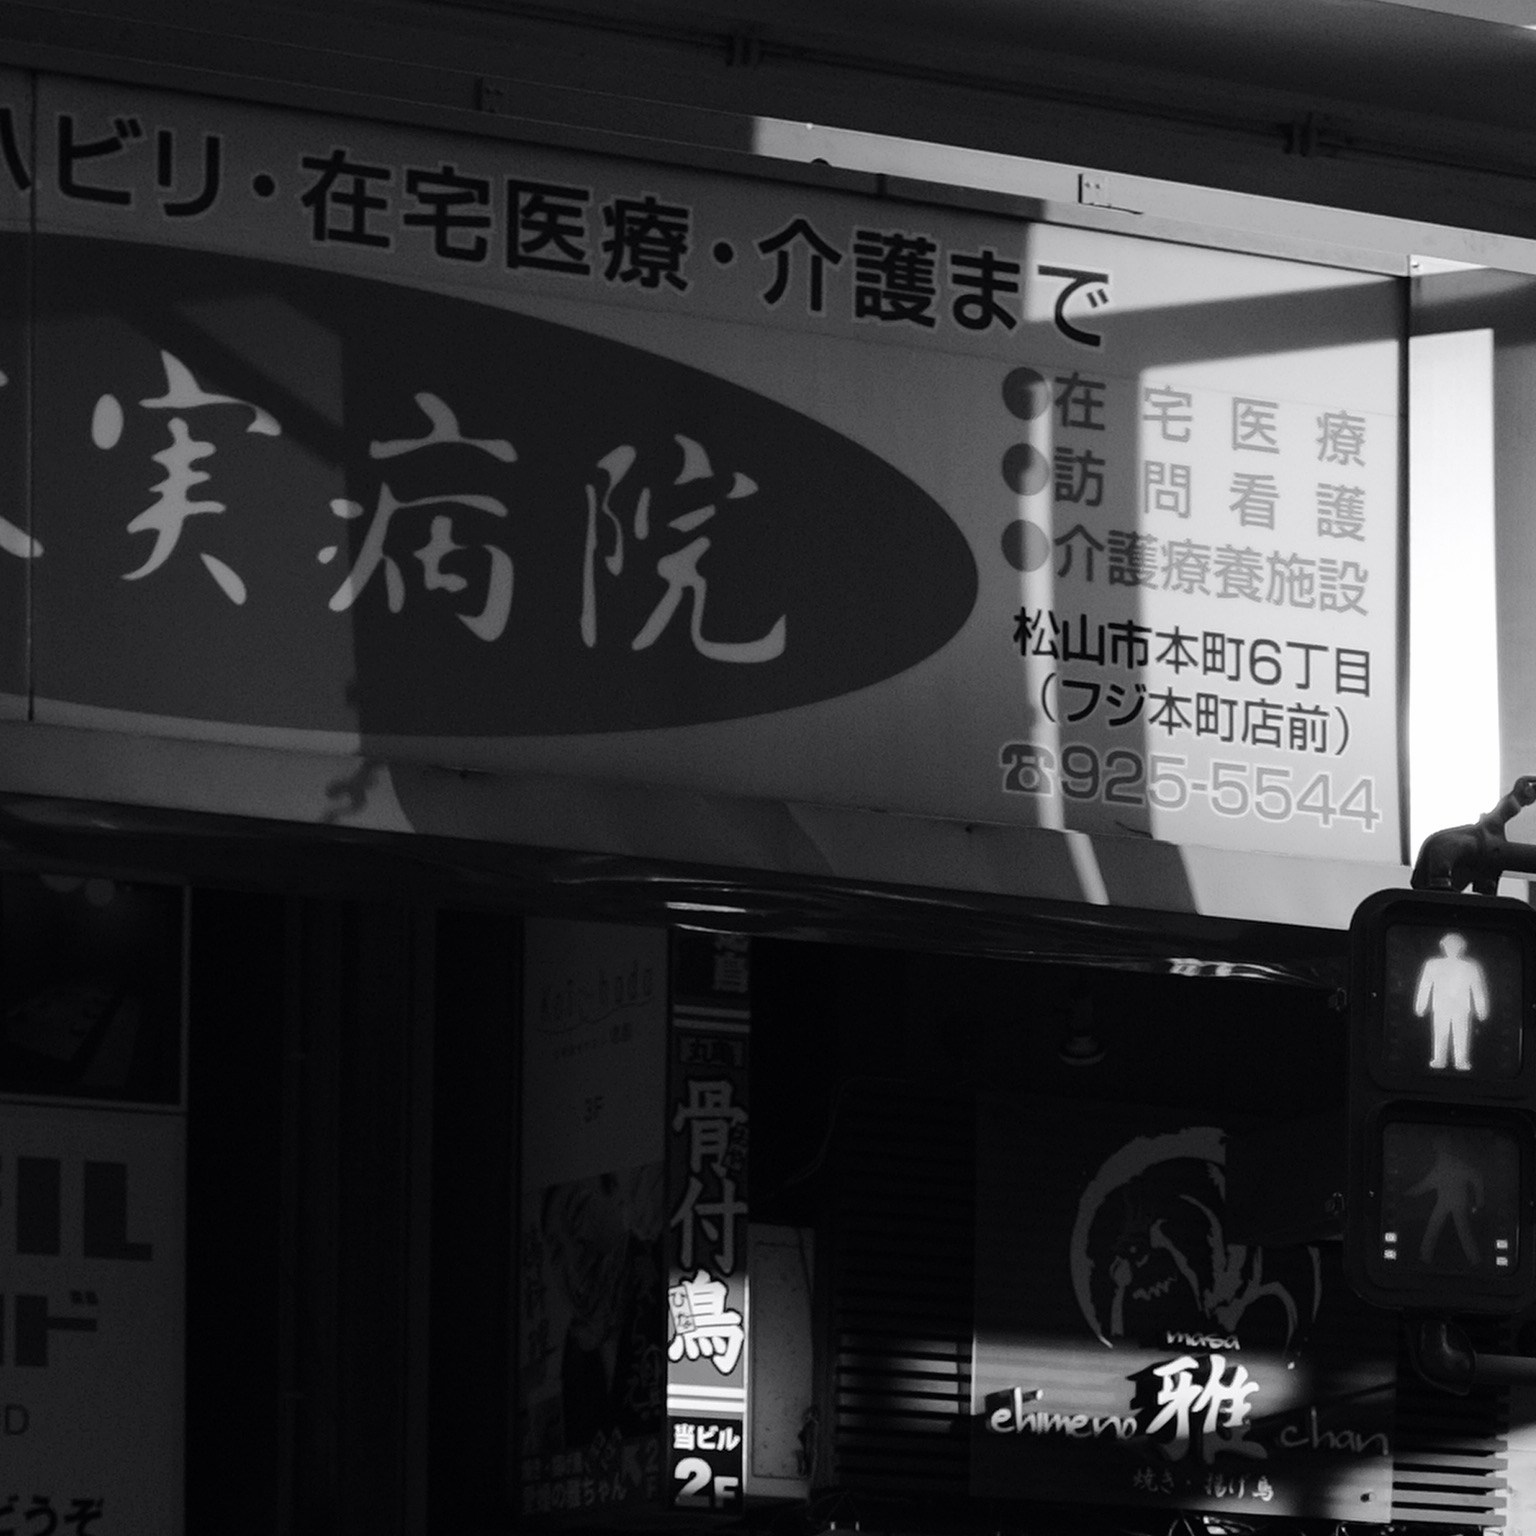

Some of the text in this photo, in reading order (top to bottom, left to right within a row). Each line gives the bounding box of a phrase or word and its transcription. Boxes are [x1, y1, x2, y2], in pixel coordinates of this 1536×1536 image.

[1054, 371, 1367, 467] 在宅医療
[0, 349, 787, 664] 実病院
[1053, 447, 1367, 543] 訪問看護
[1054, 525, 1370, 617] 介護療養施設
[1013, 606, 1372, 698] 松山市本町6丁目
[1061, 744, 1382, 833] 925-5544
[666, 1078, 750, 1375] 骨付鳥
[672, 1422, 741, 1453] 当ビル
[1145, 1353, 1269, 1466] 雅
[1279, 1405, 1390, 1456] chan
[672, 1454, 741, 1510] 2F
